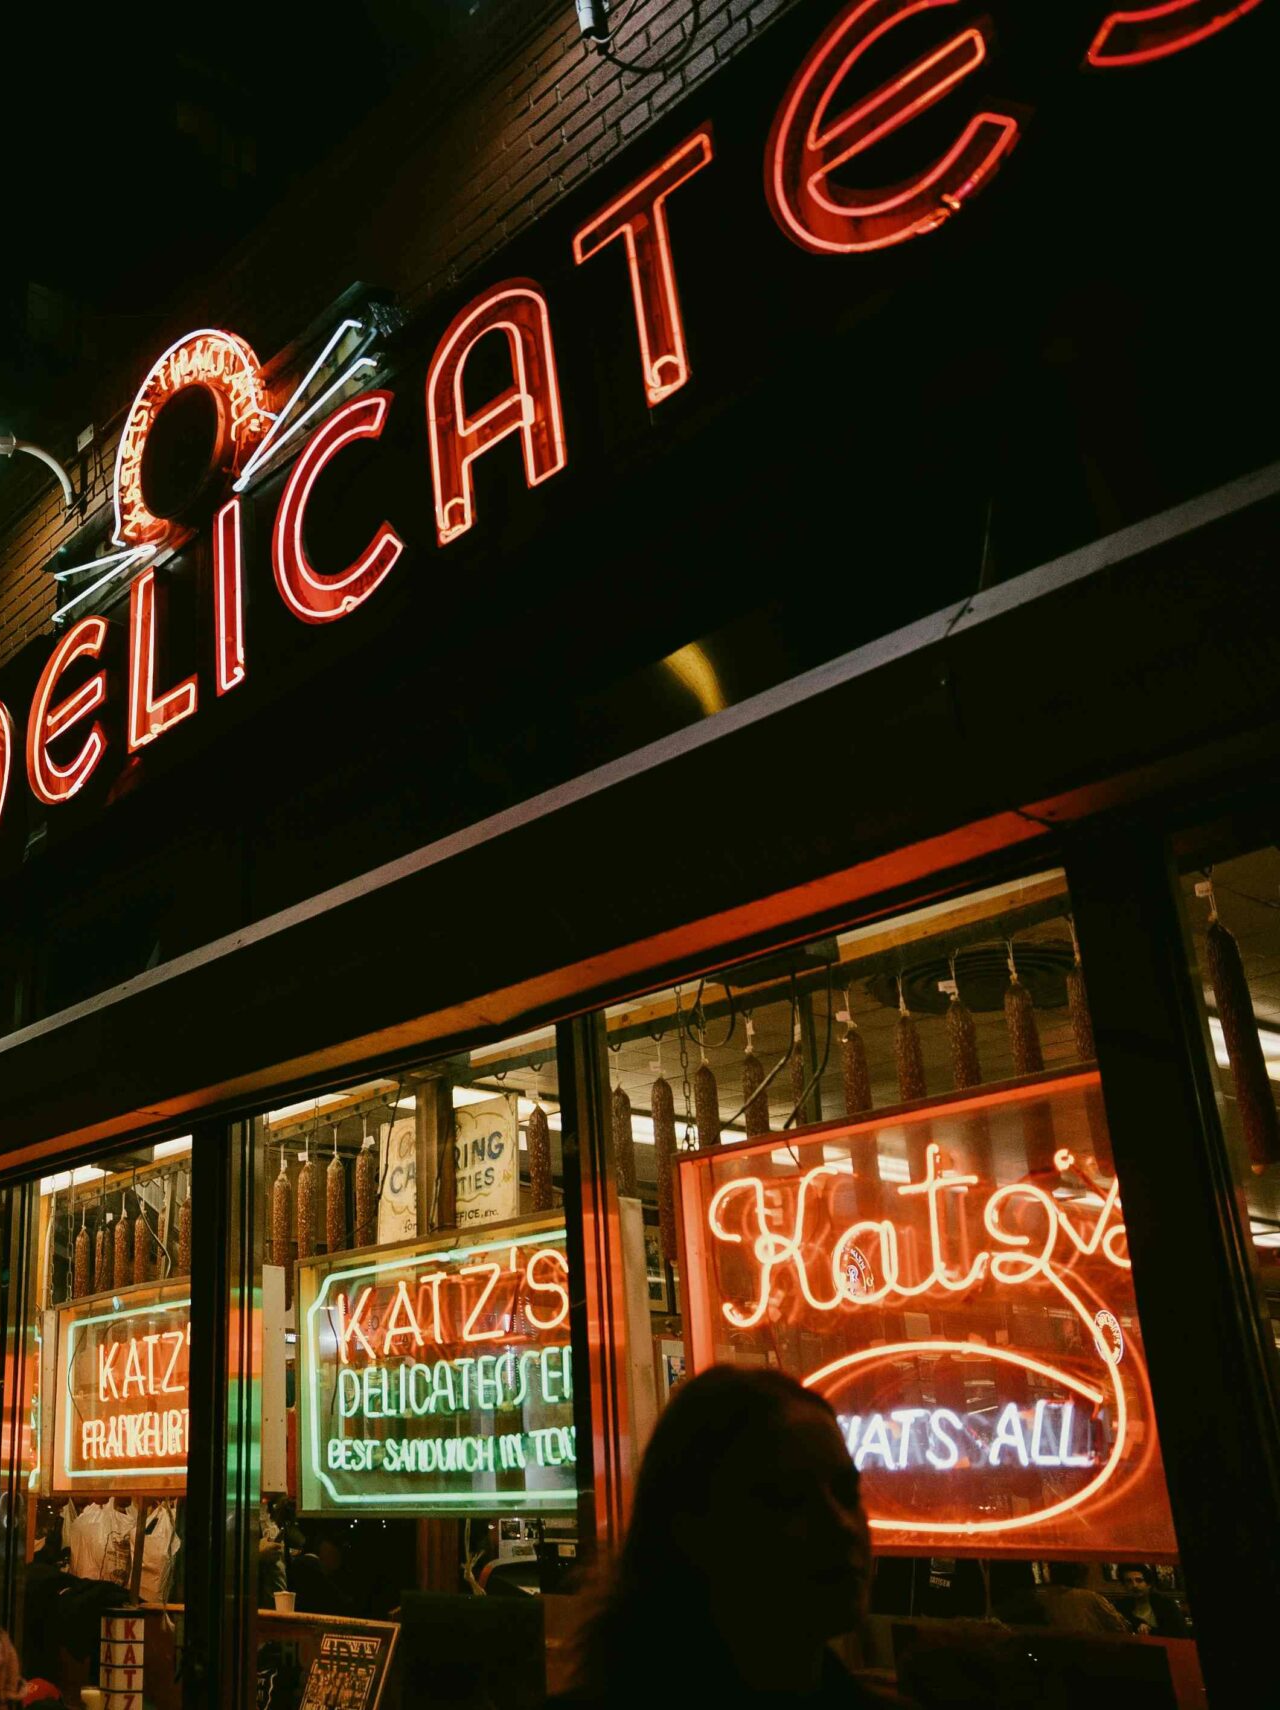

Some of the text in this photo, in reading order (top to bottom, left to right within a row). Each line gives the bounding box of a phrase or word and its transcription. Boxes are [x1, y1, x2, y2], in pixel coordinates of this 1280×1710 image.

[337, 1245, 570, 1365] KATZ'S
[327, 1438, 380, 1471] BEST
[382, 1435, 495, 1473] SANDWICH
[498, 1433, 526, 1470] IN
[988, 1400, 1095, 1467] ALL
